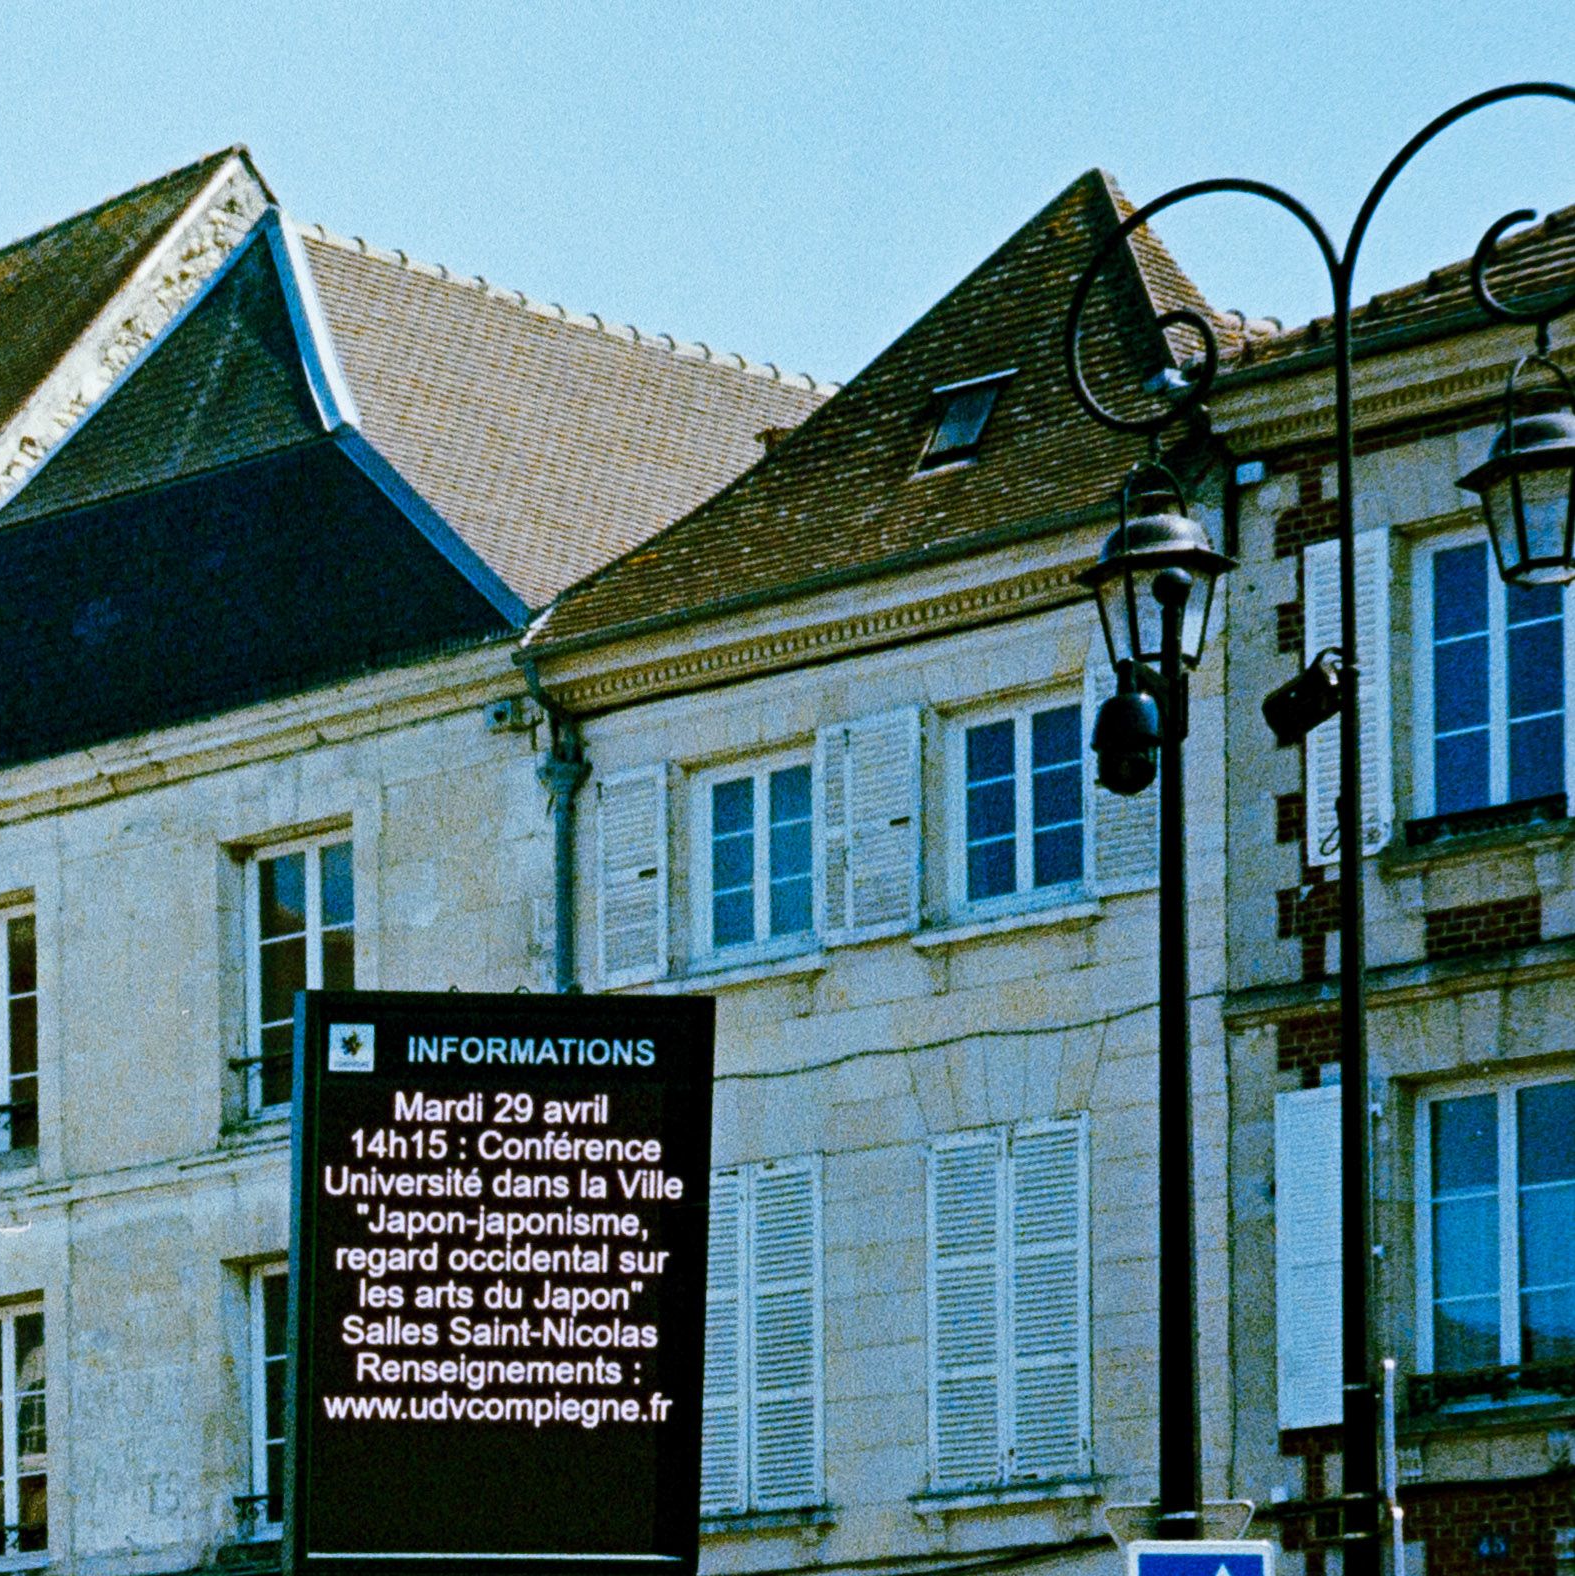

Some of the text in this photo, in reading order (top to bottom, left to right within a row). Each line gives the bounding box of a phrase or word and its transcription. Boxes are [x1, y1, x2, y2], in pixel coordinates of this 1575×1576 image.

[408, 1036, 655, 1066] INFORMATIONS
[394, 1090, 609, 1124] Mardi 29 avril
[351, 1128, 448, 1160] 14h15
[477, 1129, 662, 1163] Conférence
[324, 1165, 684, 1200] Université dans la Ville
[356, 1203, 649, 1241] "Japon-japonisme,
[335, 1242, 670, 1276] regard occidental sur
[359, 1279, 644, 1317] les arts du Japon"
[341, 1314, 659, 1348] Salles Saint-Nicolas
[356, 1351, 623, 1388] Renseignements
[323, 1390, 673, 1428] www.udvcompiegne.fr
